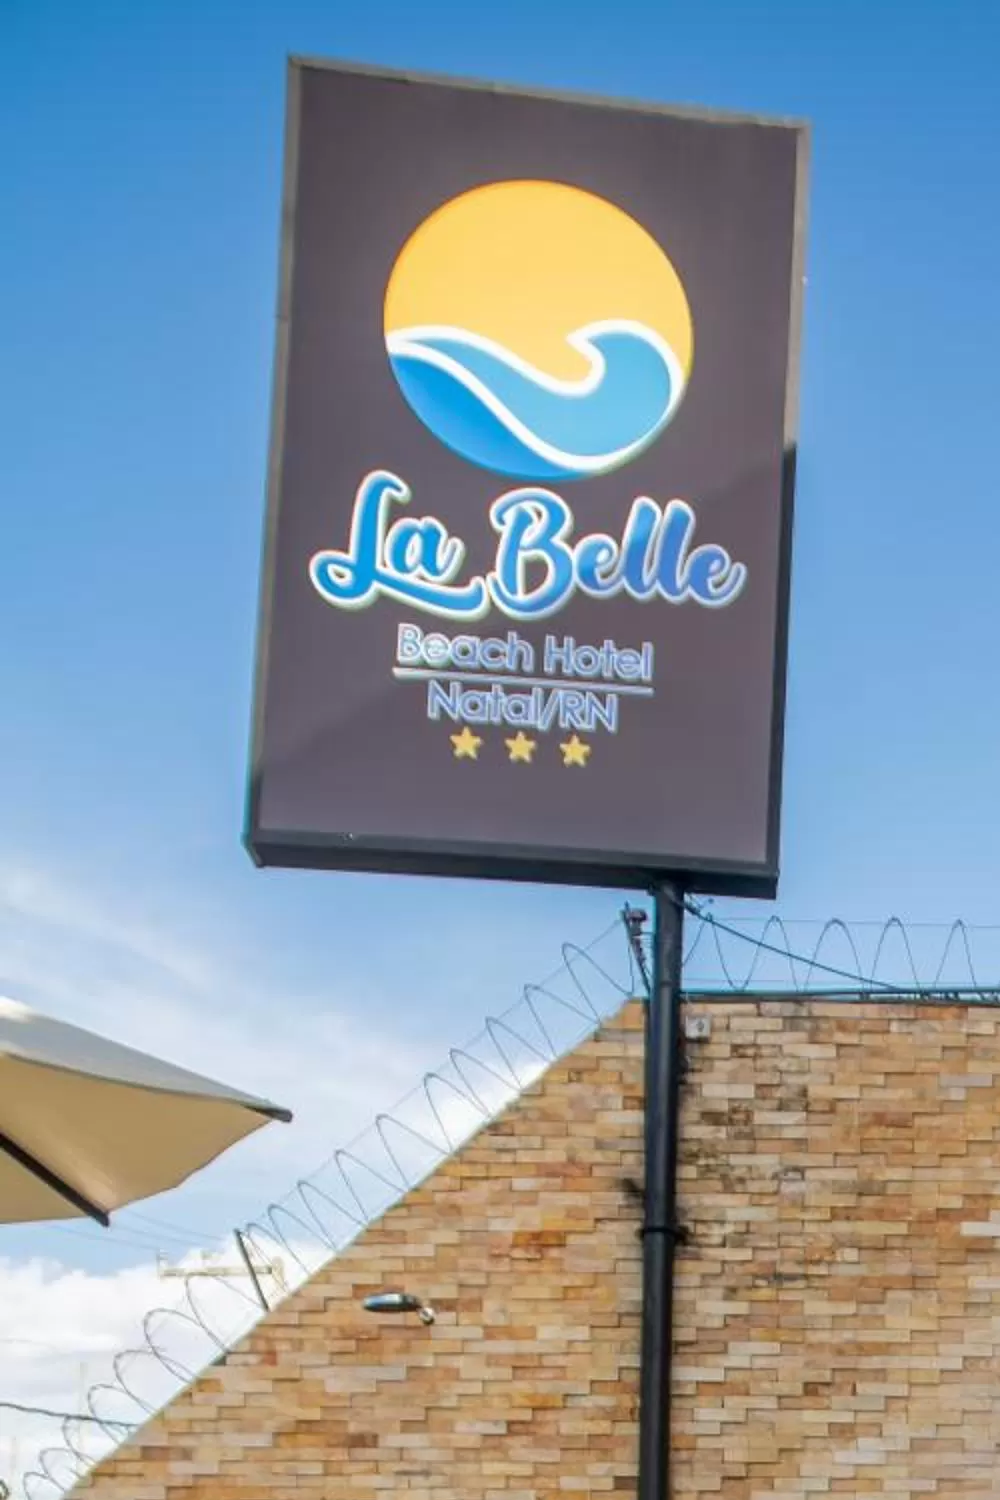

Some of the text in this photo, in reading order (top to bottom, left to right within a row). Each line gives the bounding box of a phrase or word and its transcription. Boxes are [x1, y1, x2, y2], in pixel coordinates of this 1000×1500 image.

[310, 470, 747, 620] La Belle
[396, 623, 654, 681] Beach Hotel
[427, 680, 618, 732] Natal/RN
